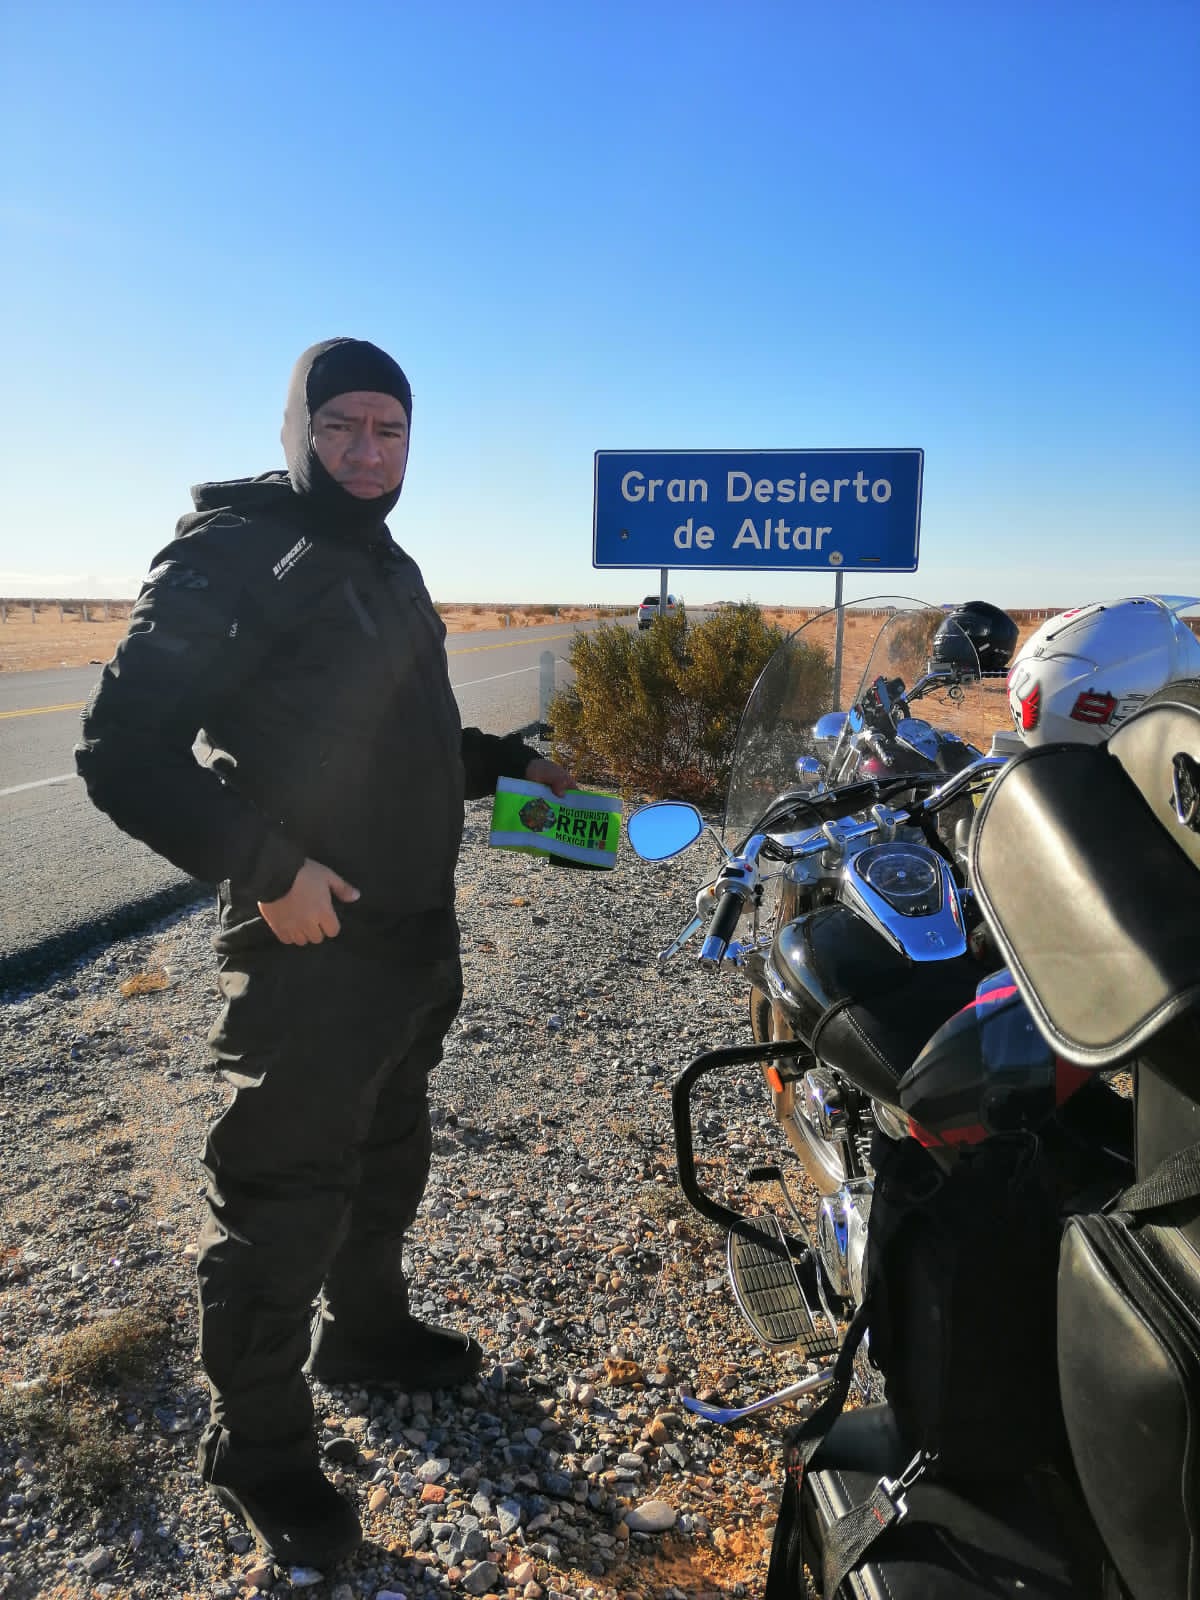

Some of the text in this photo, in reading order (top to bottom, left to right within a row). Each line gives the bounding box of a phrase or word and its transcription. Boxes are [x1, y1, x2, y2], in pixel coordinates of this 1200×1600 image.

[620, 470, 892, 503] Gran Desierto
[673, 518, 833, 550] de Altar
[556, 815, 608, 840] RRM
[559, 806, 609, 821] MOTOTURISTA
